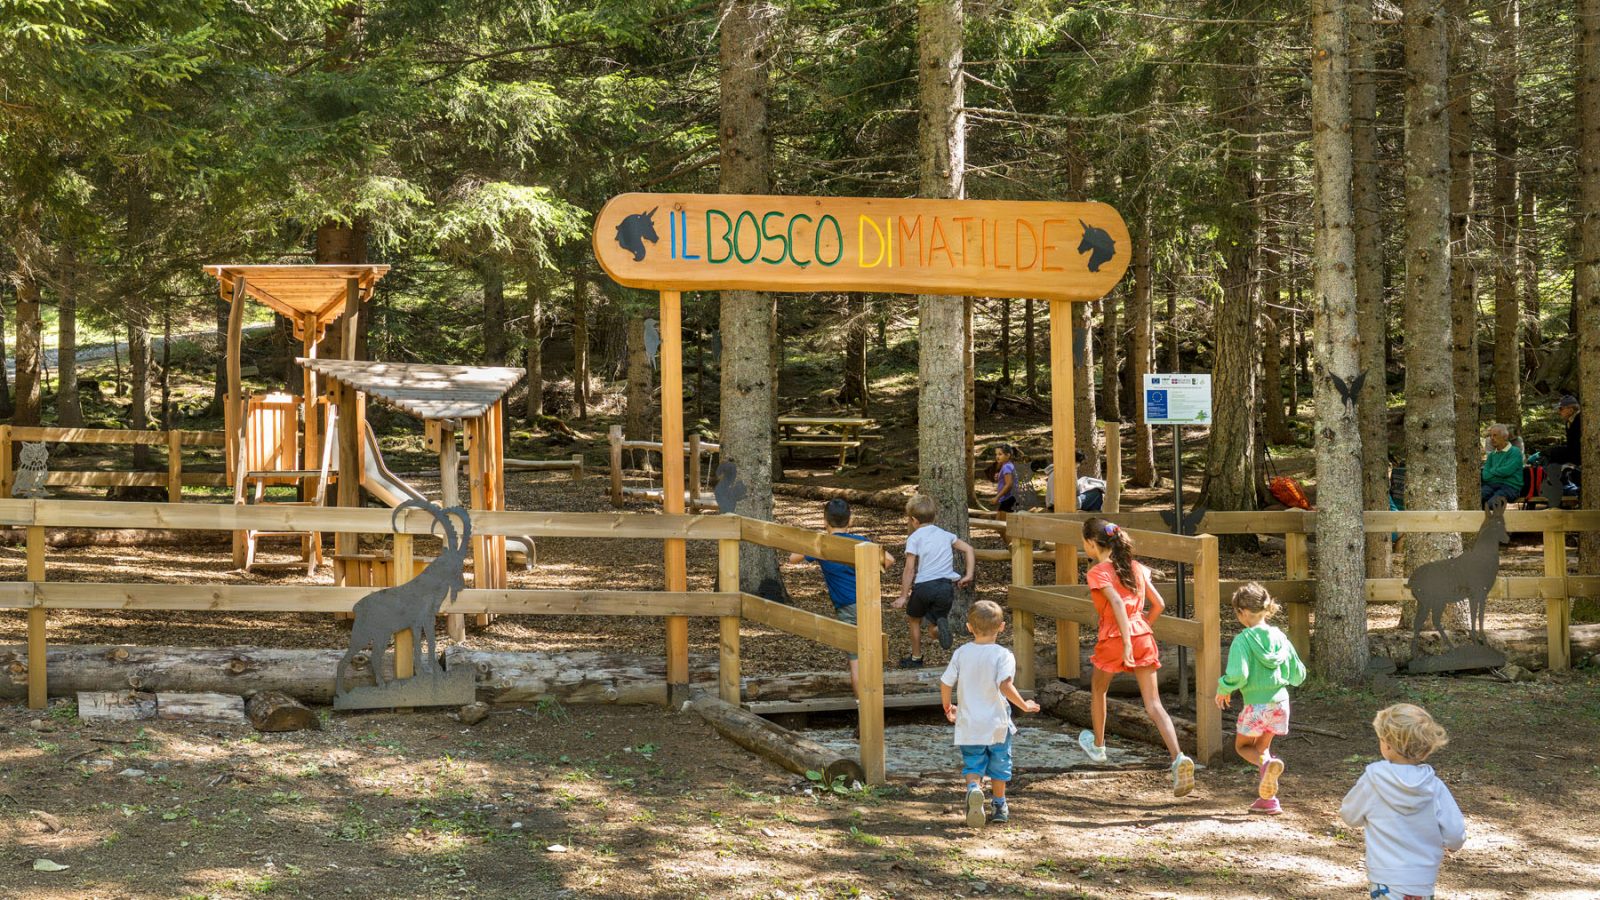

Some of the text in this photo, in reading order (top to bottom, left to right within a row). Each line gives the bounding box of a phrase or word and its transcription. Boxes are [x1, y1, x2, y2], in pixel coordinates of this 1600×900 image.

[670, 209, 1067, 272] IL BOSCO DI MATILDE
